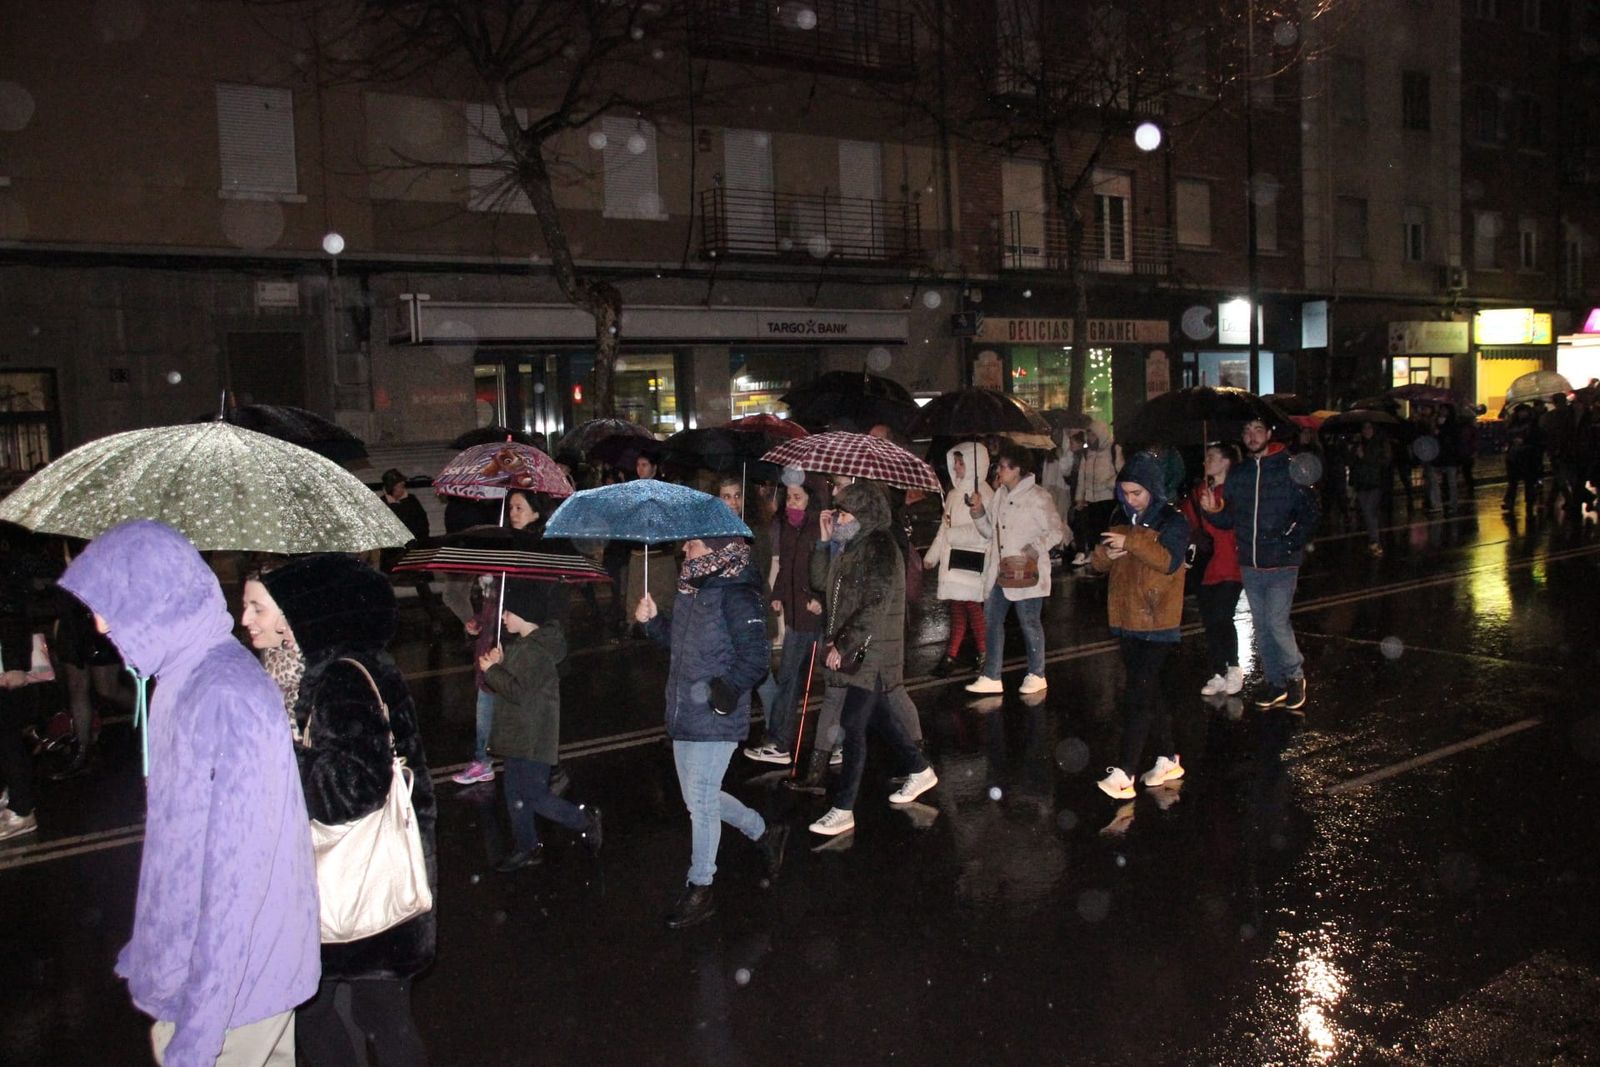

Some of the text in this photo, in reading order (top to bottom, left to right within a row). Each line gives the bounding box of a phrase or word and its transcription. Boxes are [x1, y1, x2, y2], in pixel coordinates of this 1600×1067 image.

[767, 322, 848, 334] TARGO BANK
[1008, 320, 1139, 341] DELICIAS GRANEL
